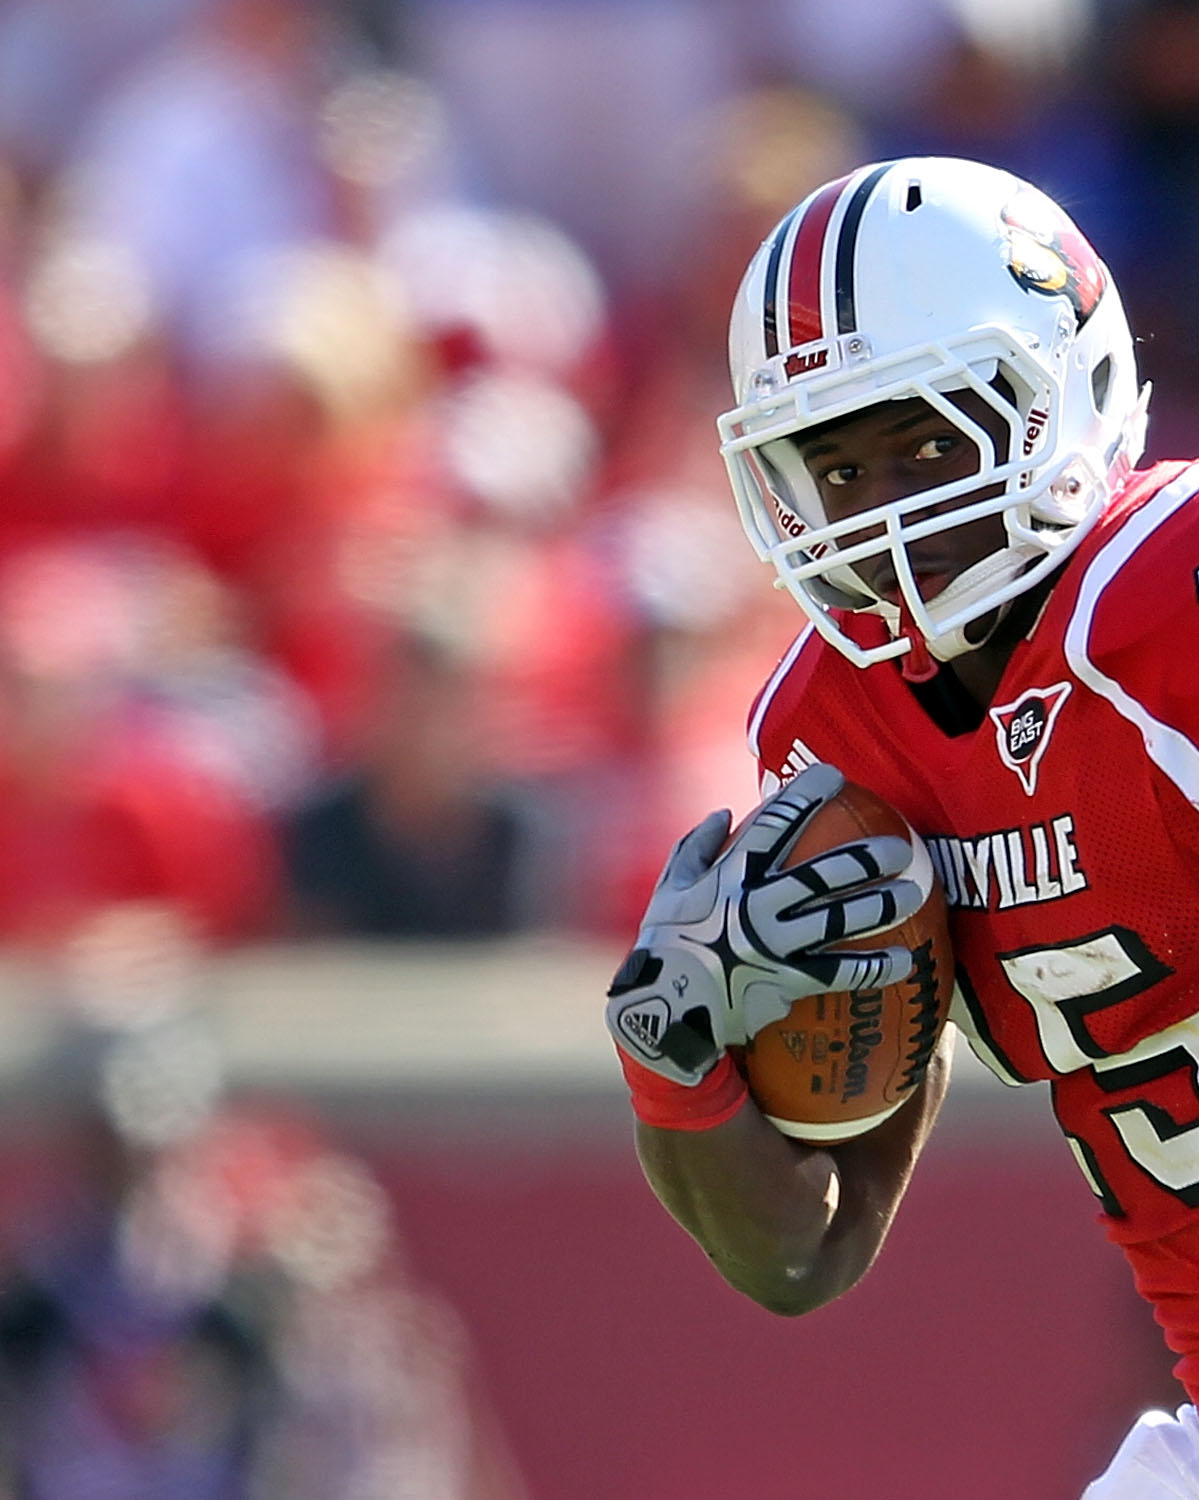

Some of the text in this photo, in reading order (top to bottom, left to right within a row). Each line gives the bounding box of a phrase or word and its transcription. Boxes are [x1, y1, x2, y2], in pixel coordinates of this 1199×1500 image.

[1010, 709, 1035, 737] BIG
[1010, 720, 1044, 753] EAST
[842, 986, 883, 1104] Wilson
